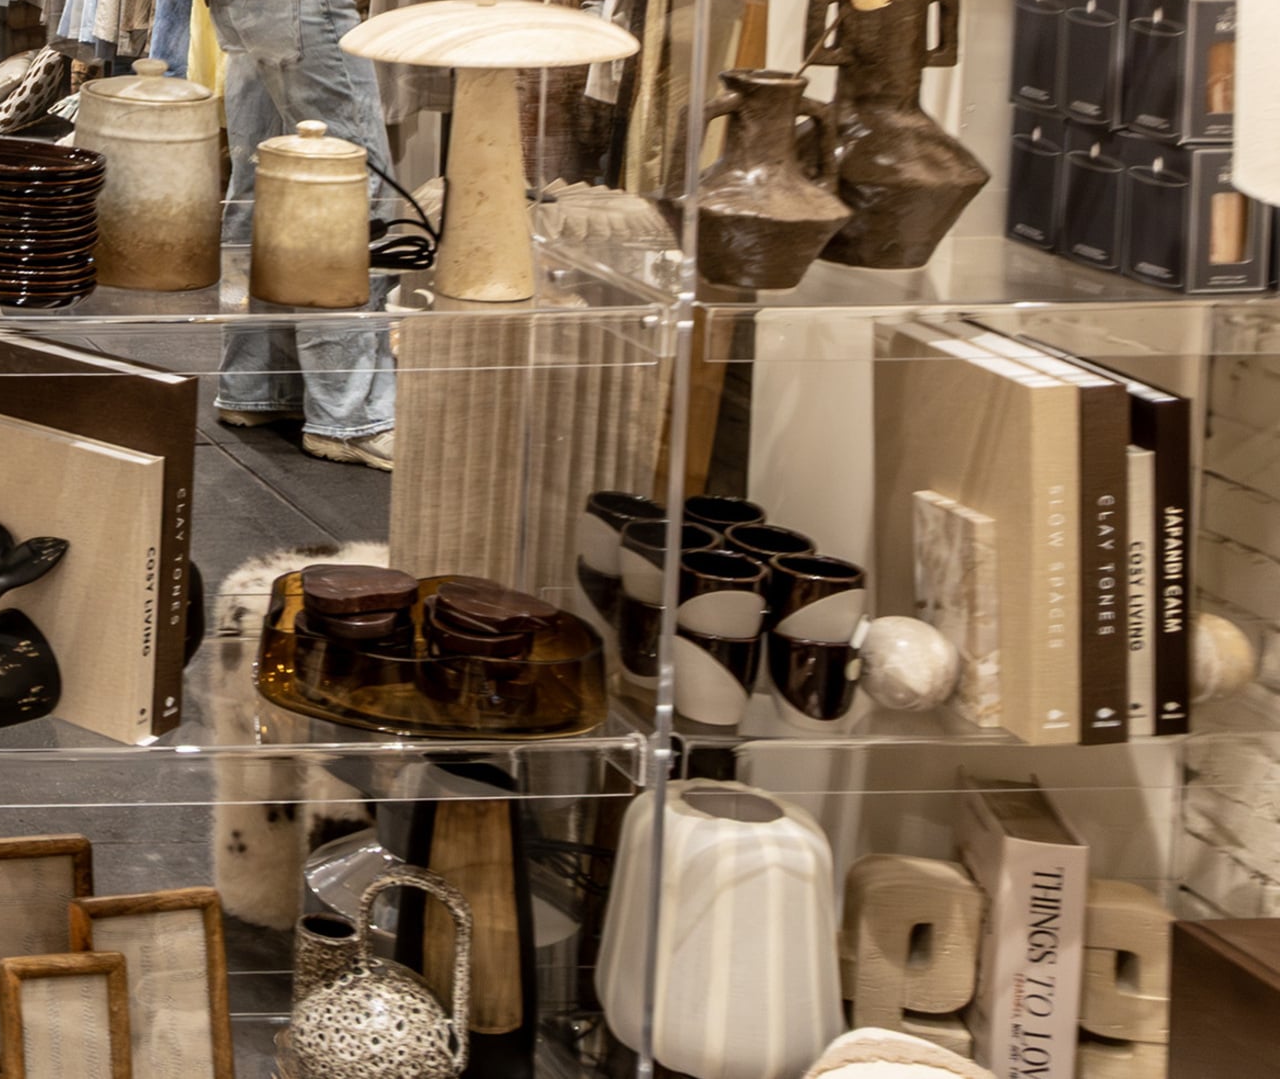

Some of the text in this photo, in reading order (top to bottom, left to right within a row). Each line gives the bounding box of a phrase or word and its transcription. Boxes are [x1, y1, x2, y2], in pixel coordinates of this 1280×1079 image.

[142, 547, 156, 657] COSY LIVING
[170, 488, 187, 625] CLAY TONES
[1048, 485, 1065, 648] SLOW SPACES
[1097, 495, 1116, 635] CLAY TONES
[1128, 540, 1145, 651] COSY LIVING
[1163, 505, 1184, 633] JAPANDI CALM
[1027, 866, 1065, 964] THINGS
[1023, 976, 1057, 1017] TO
